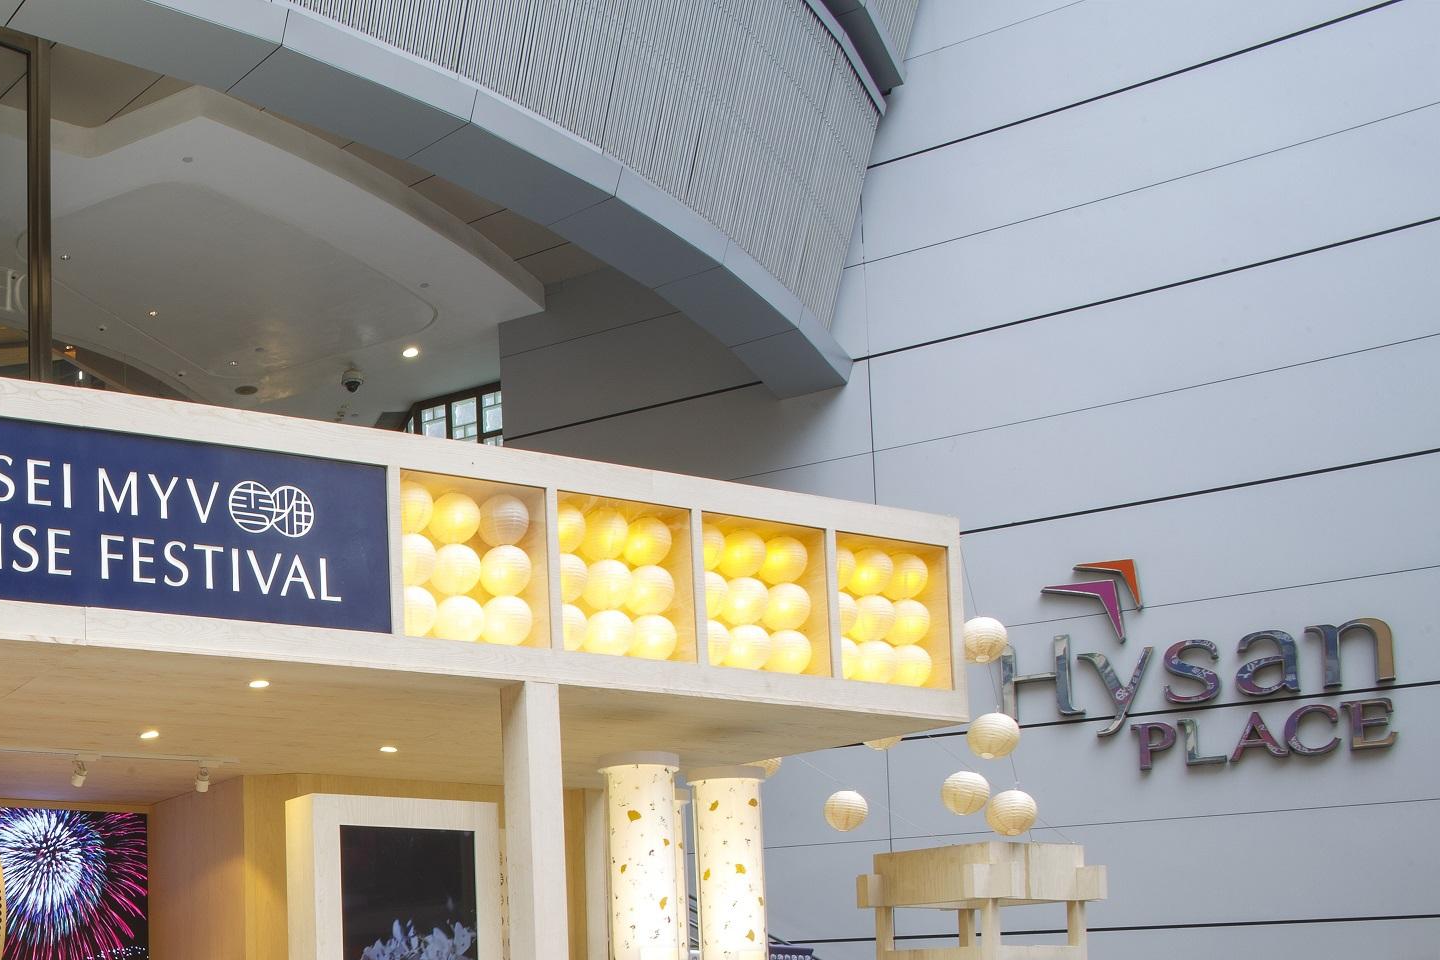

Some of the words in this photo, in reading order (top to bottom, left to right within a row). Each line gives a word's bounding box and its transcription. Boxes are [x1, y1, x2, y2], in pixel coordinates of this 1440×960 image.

[98, 467, 220, 524] MYV
[100, 534, 342, 602] FESTIVAL
[1000, 617, 1397, 738] Hysan
[1130, 697, 1399, 771] PLACE
